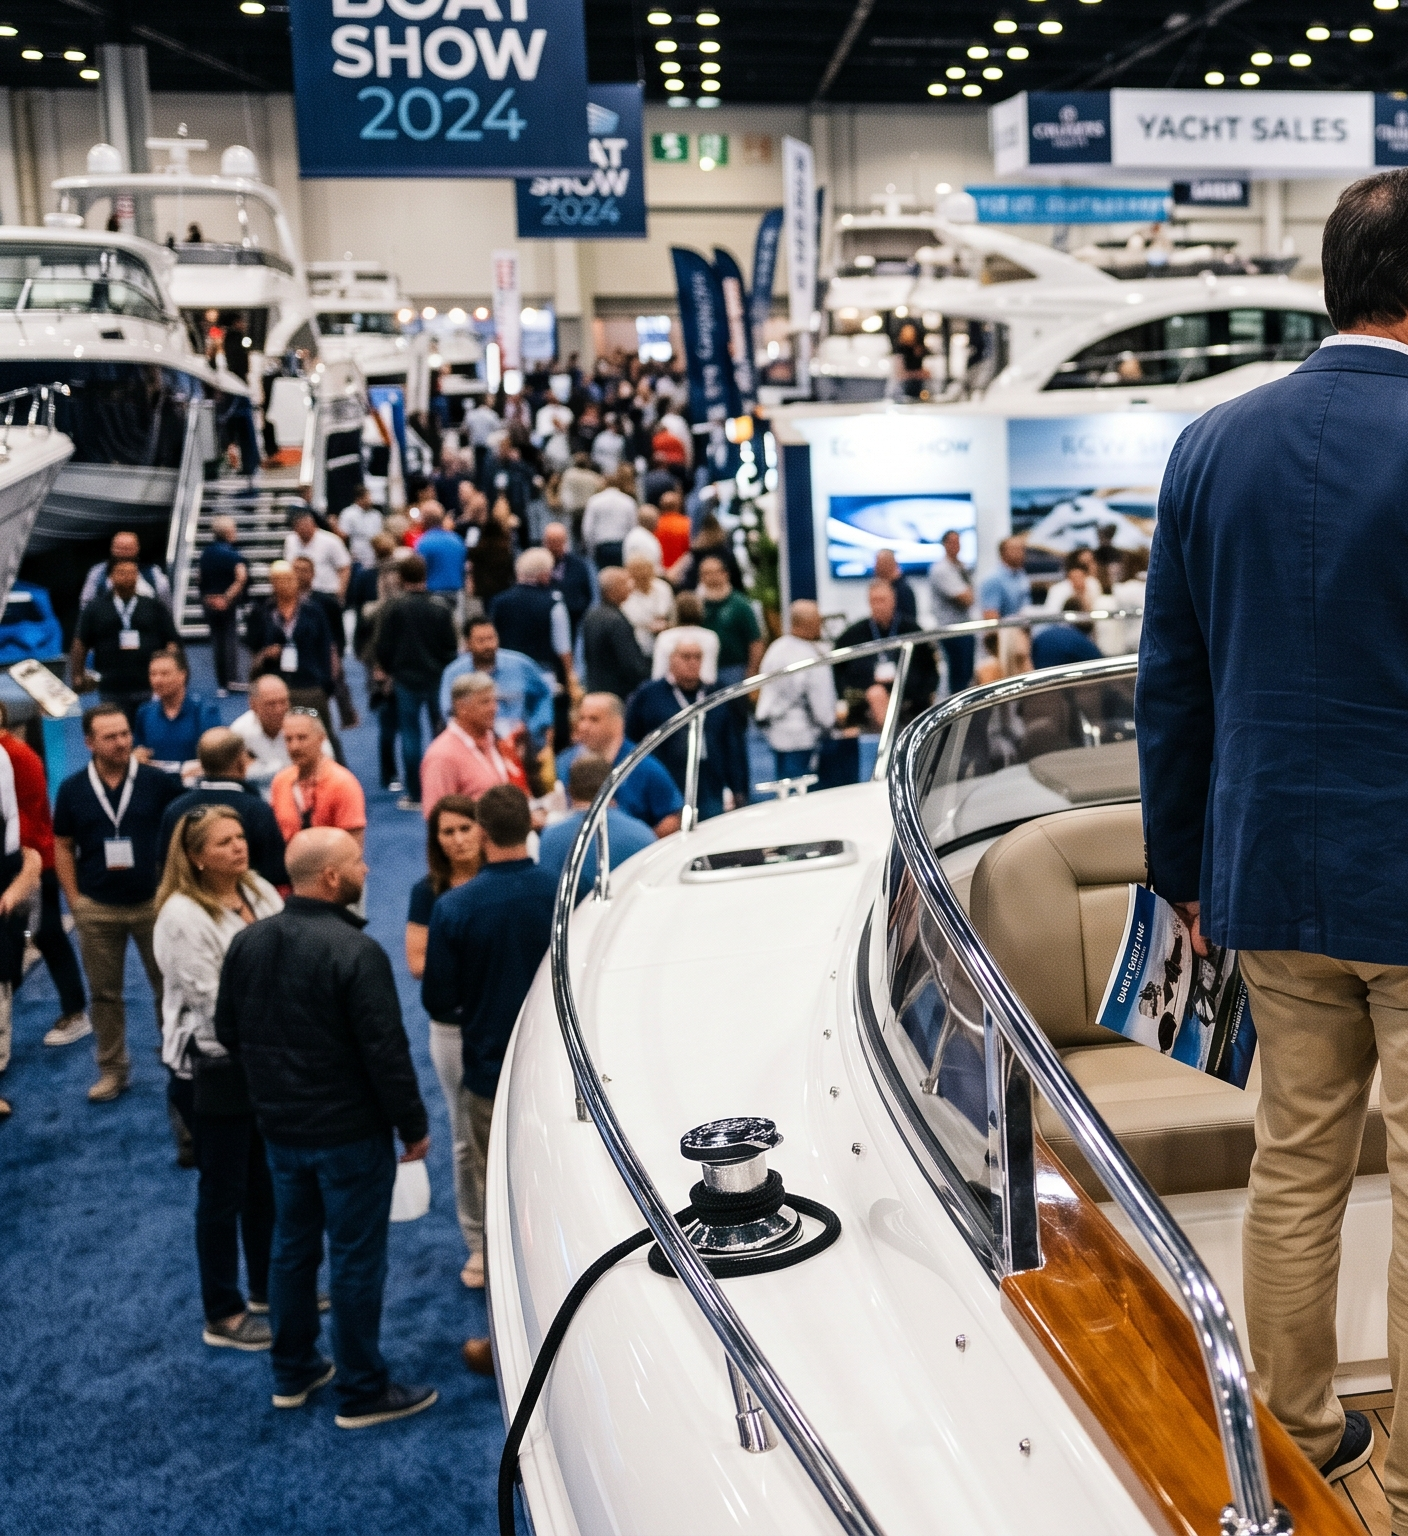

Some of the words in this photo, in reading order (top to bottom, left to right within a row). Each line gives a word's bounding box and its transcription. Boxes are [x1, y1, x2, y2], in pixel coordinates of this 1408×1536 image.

[331, 24, 547, 81] SHOW
[357, 85, 528, 142] 2024
[1137, 114, 1241, 142] YACHT
[1252, 116, 1347, 142] SALES
[539, 196, 620, 226] 2024
